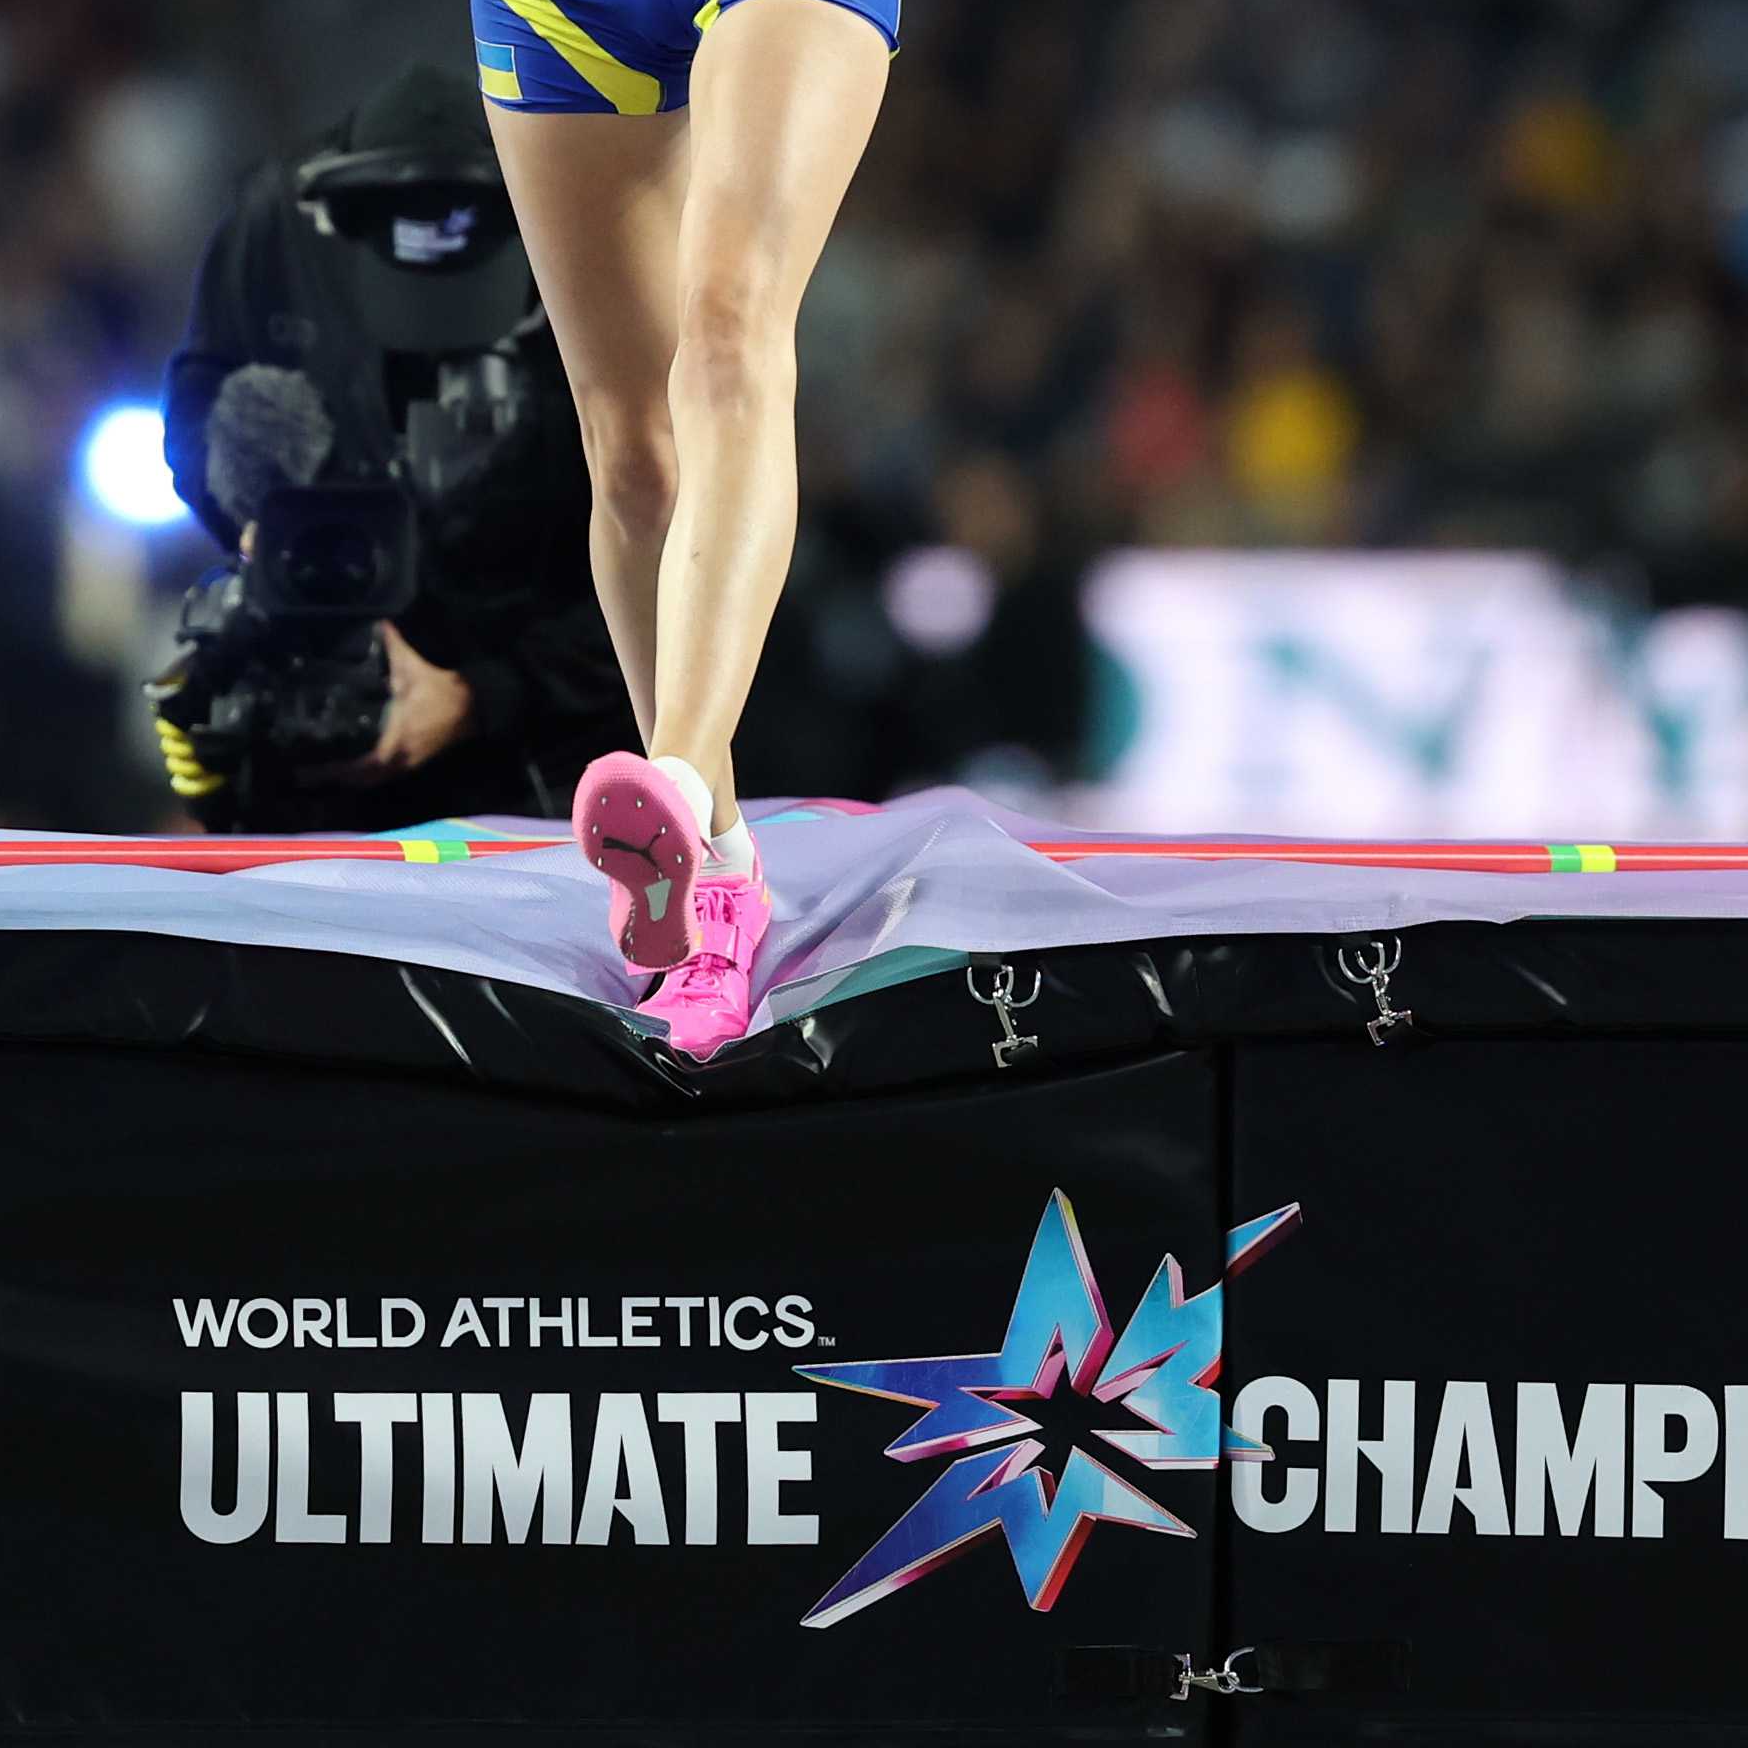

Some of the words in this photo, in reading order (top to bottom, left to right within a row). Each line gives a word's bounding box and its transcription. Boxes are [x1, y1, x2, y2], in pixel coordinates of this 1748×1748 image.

[172, 1297, 426, 1349] WORLD
[440, 1294, 815, 1351] ATHLETICS
[179, 1391, 820, 1546] ULTIMATE
